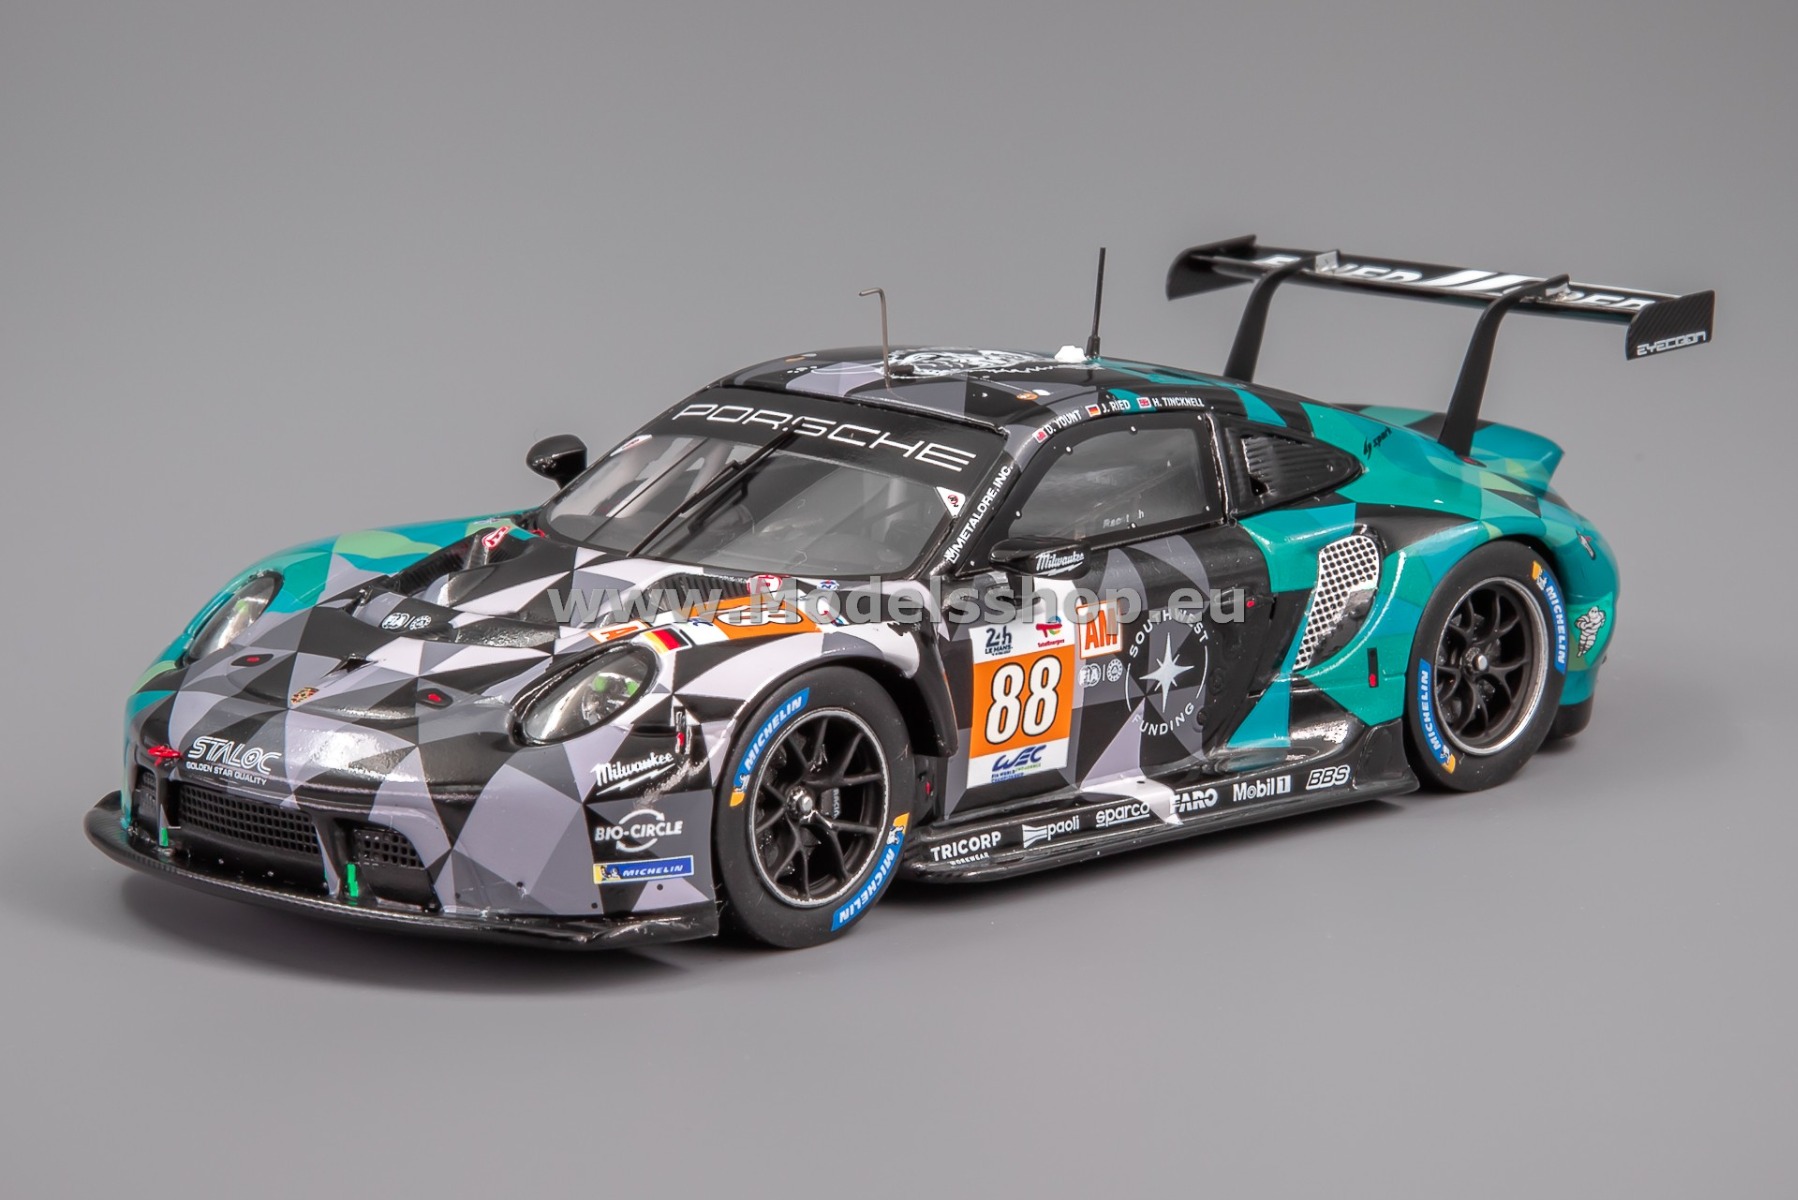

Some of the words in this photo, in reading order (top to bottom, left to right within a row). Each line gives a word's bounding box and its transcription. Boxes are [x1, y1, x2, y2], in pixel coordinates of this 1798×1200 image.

[1113, 399, 1131, 412] RIED
[1165, 396, 1206, 408] TINCKNELL
[1053, 409, 1083, 430] YOUNT
[672, 402, 978, 473] PORSCHE
[1035, 550, 1085, 571] Milwaukee
[985, 624, 1012, 648] 24h
[1129, 607, 1209, 658] SOUTHWEST
[1545, 585, 1566, 664] MICHELIN
[984, 654, 1063, 746] 88
[1421, 670, 1441, 750] MICHELIN
[744, 695, 802, 770] MICHELIN
[1132, 702, 1196, 737] FUNDING
[187, 735, 282, 776] STALOC
[590, 752, 674, 786] Milwaukee
[992, 744, 1047, 772] WEC
[185, 761, 212, 772] GOLDEN
[213, 766, 233, 777] STAR
[234, 770, 267, 786] QUALITY
[1305, 764, 1351, 791] BBS
[1095, 802, 1151, 827] sparco
[1170, 788, 1219, 814] FARO
[594, 820, 684, 842] BIO-CIRCLE
[1046, 816, 1080, 841] paoli
[930, 831, 1002, 862] TRICORP
[622, 864, 684, 878] MICHELIN
[838, 848, 896, 923] MICHELIN
